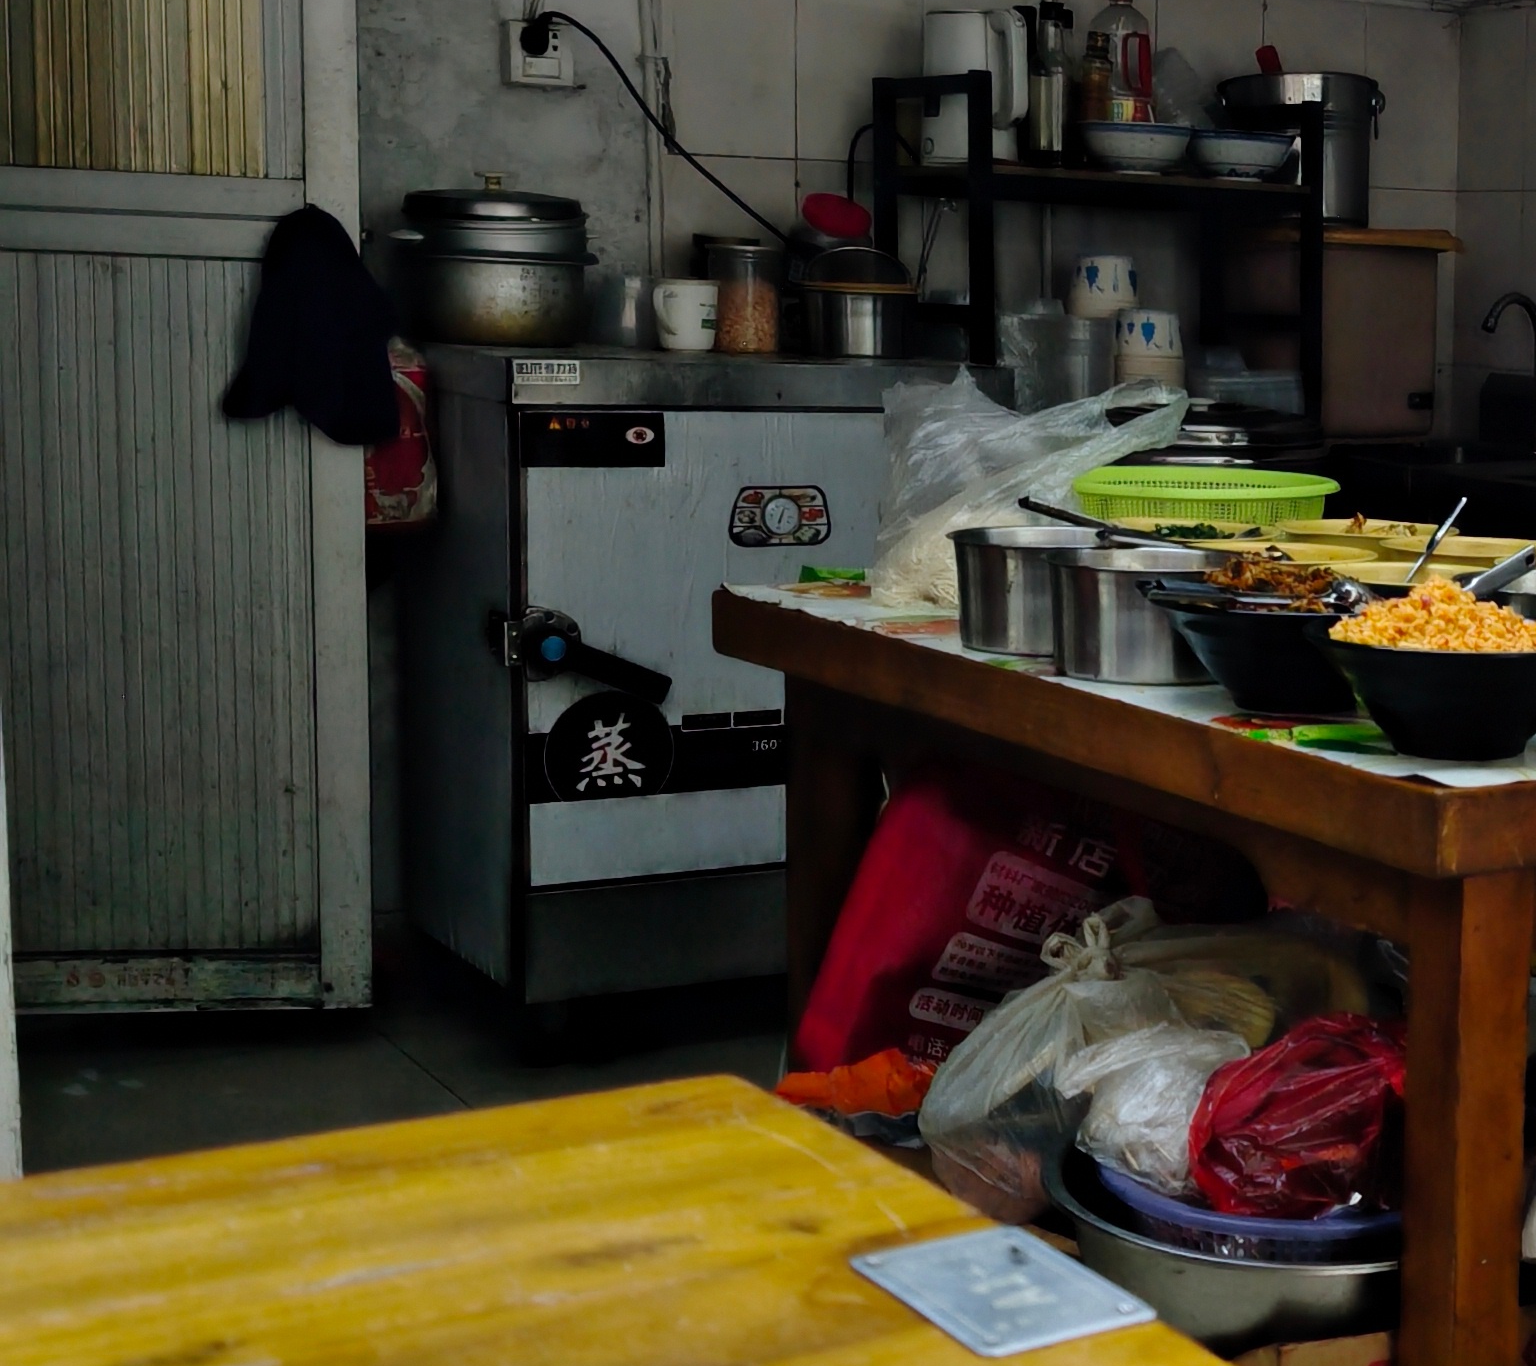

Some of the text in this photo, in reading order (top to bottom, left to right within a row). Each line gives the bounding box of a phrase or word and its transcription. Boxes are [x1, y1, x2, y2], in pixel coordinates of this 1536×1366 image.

[576, 712, 647, 793] 蒸
[915, 994, 985, 1025] 活动时间
